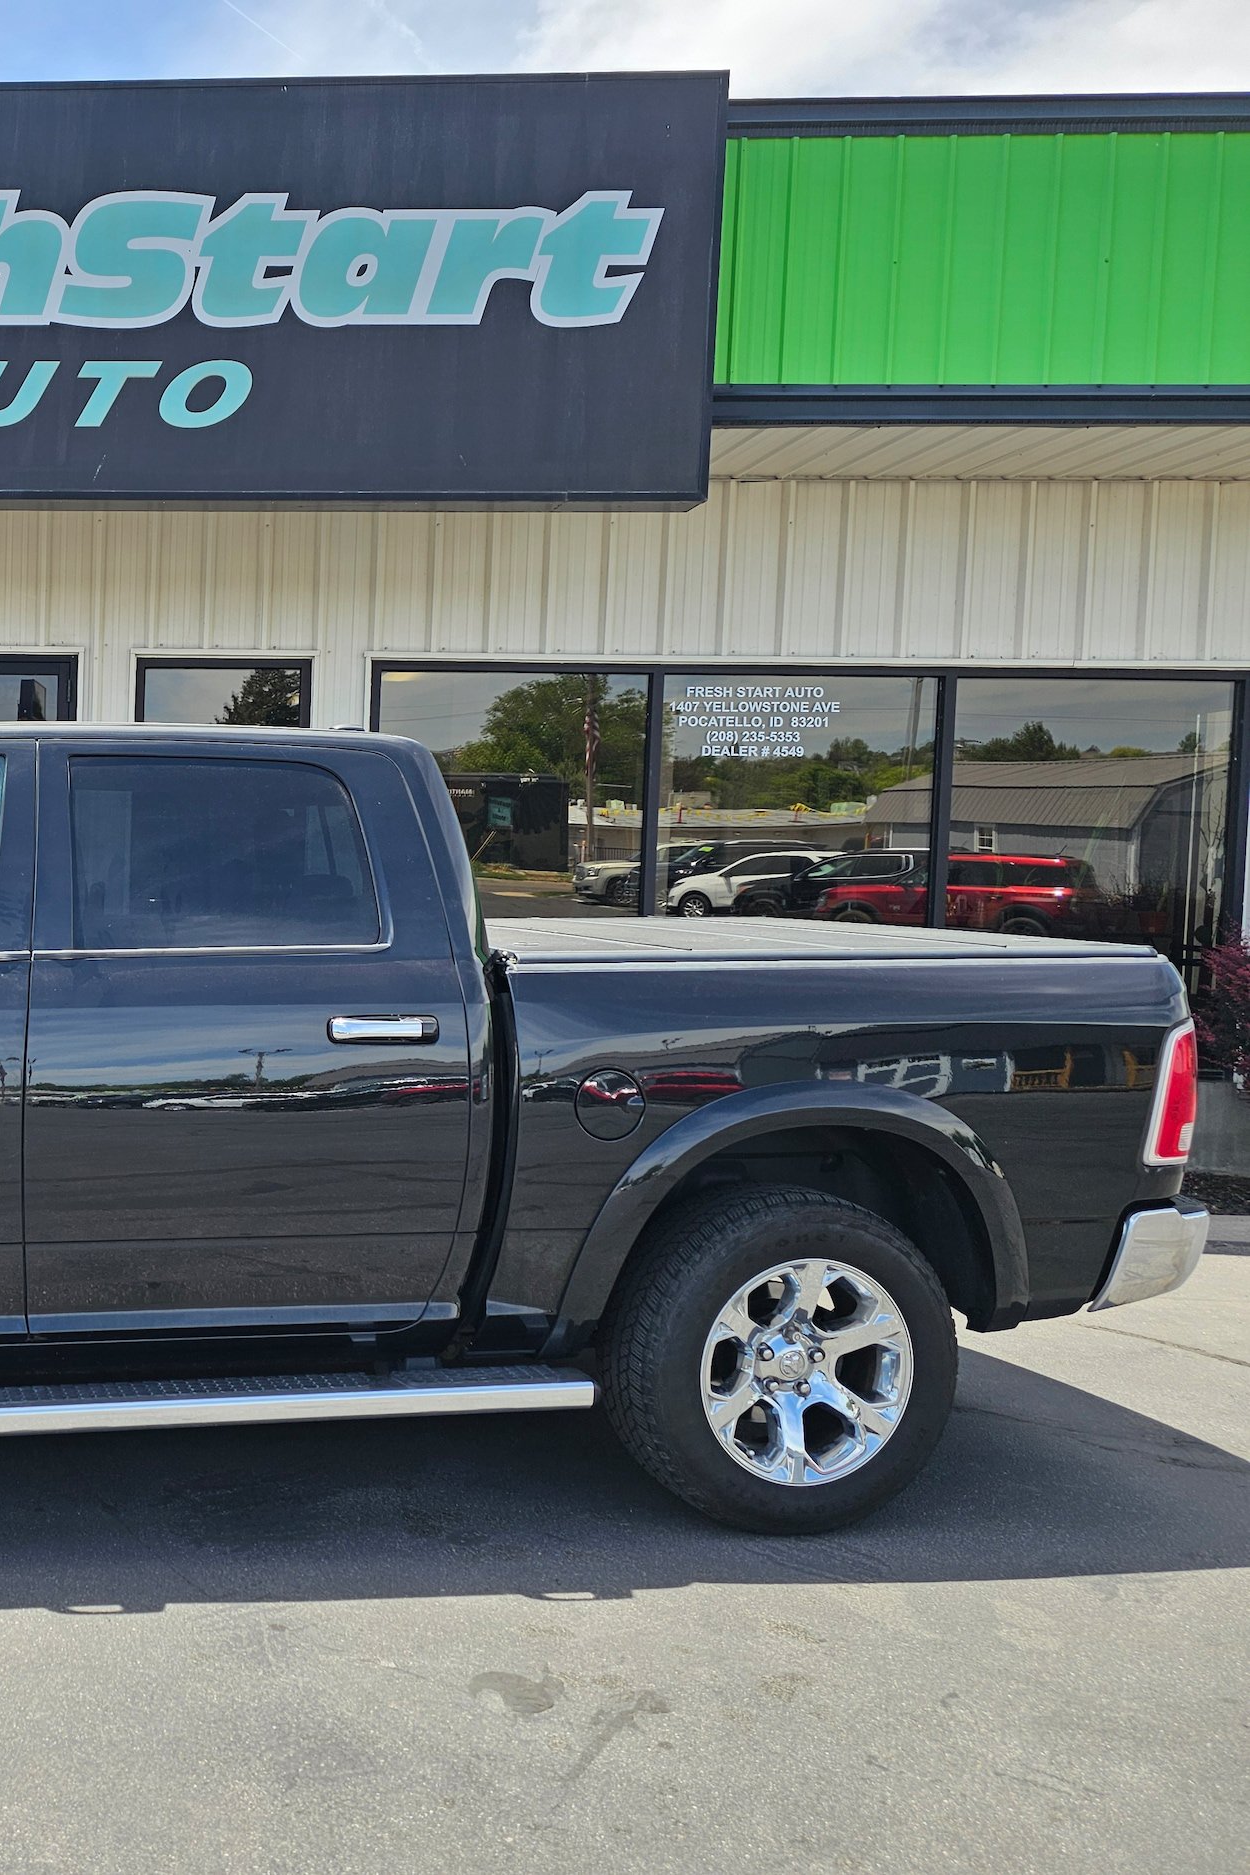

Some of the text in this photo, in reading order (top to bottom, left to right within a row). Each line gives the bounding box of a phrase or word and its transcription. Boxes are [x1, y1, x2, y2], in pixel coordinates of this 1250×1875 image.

[686, 686, 824, 698] FRESH START AUTO
[669, 702, 840, 713] 1407 YELLOWSTONE AVE
[678, 716, 829, 729] POCATELLO, ID 83201
[706, 731, 801, 744] (208) 235-5353
[701, 745, 758, 757] DEALER
[773, 746, 805, 757] 4549
